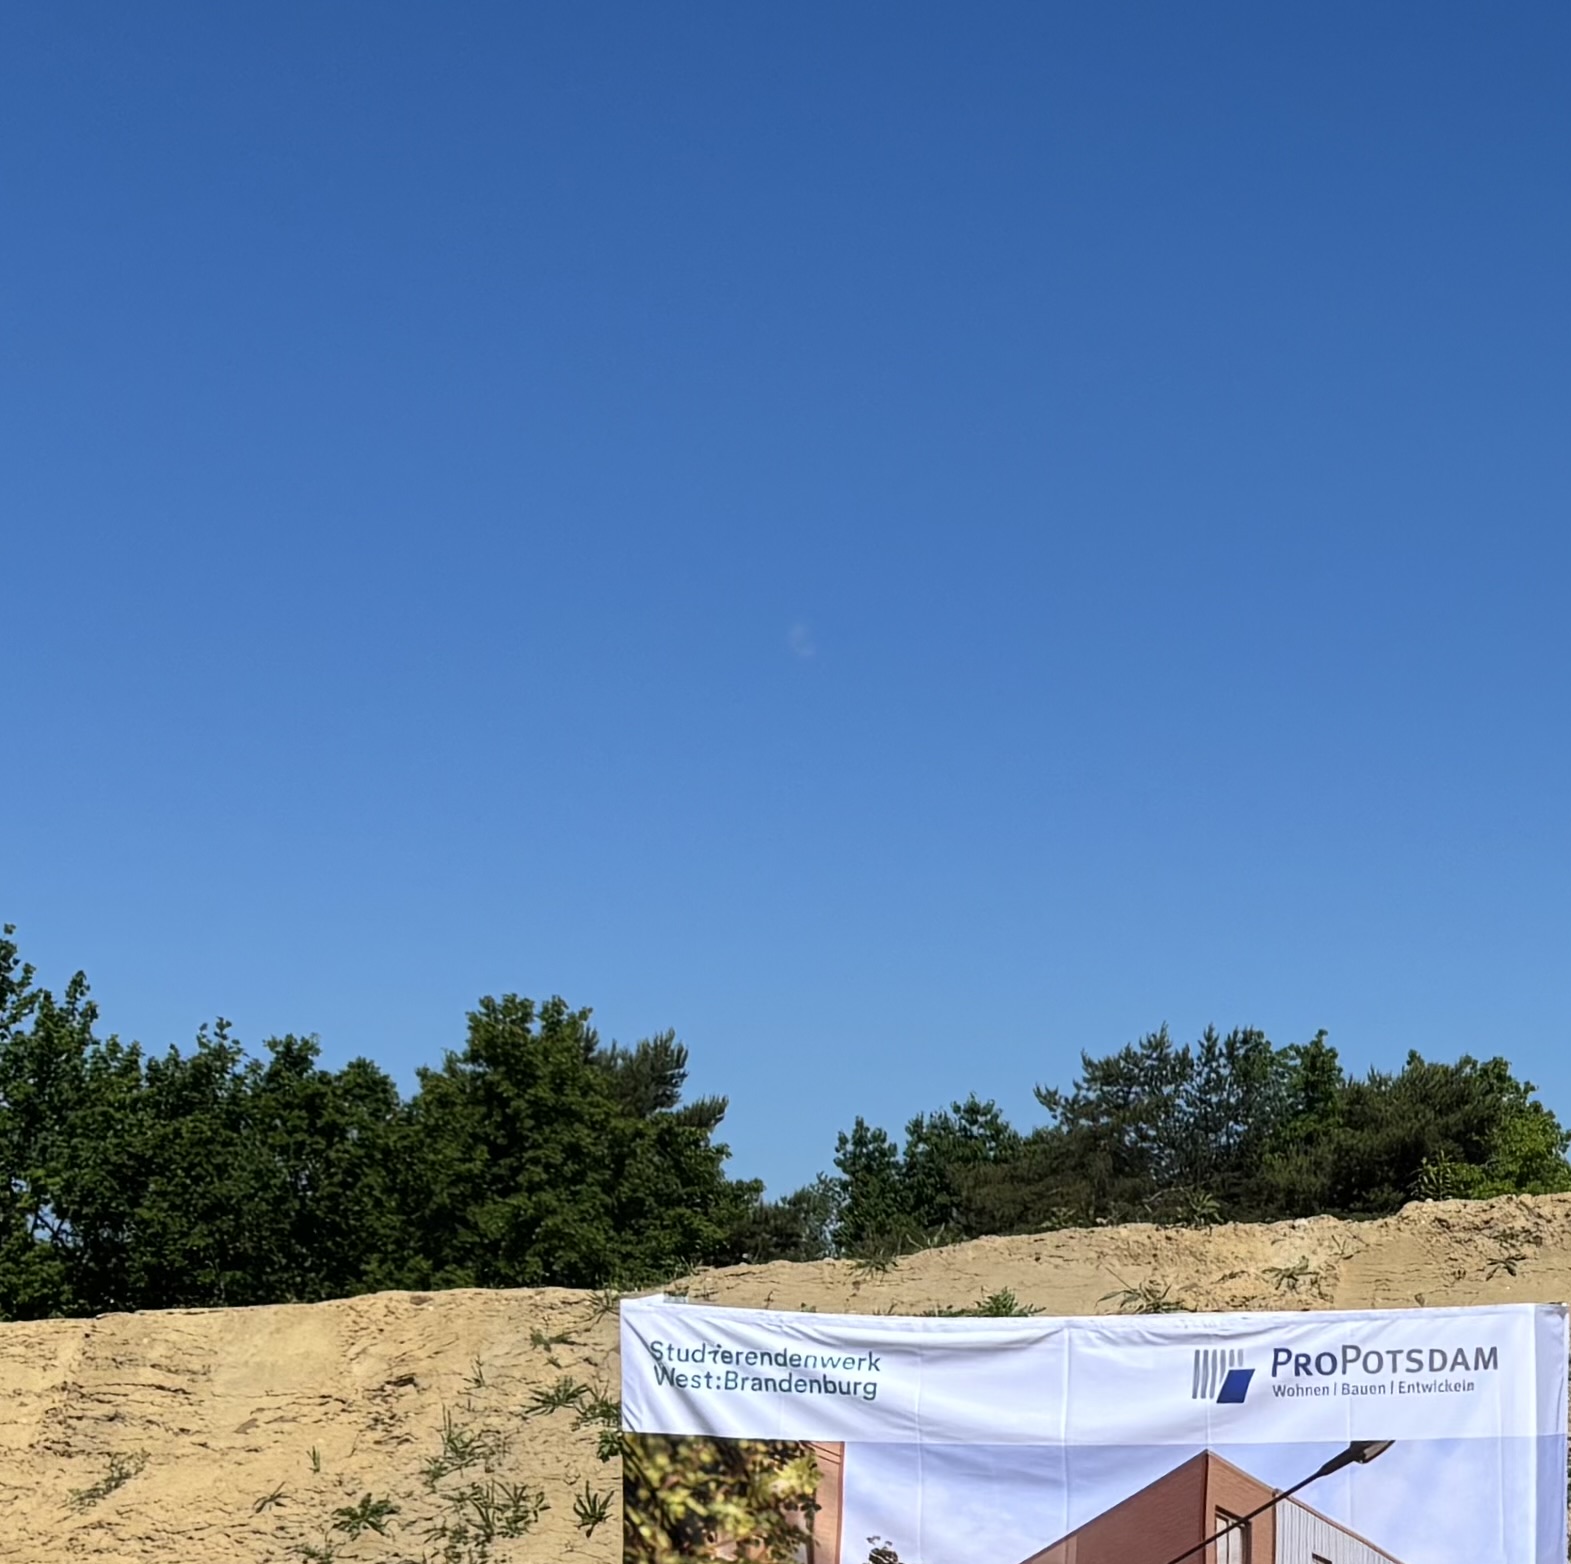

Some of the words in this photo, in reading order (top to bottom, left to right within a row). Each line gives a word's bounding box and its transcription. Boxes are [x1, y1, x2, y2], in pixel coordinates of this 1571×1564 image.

[650, 1340, 881, 1371] Studierendenwerk
[653, 1364, 877, 1401] West:Brandenburg
[1272, 1383, 1330, 1398] Wohnen
[1341, 1382, 1385, 1396] Bauen
[1398, 1380, 1475, 1394] Entwickeln
